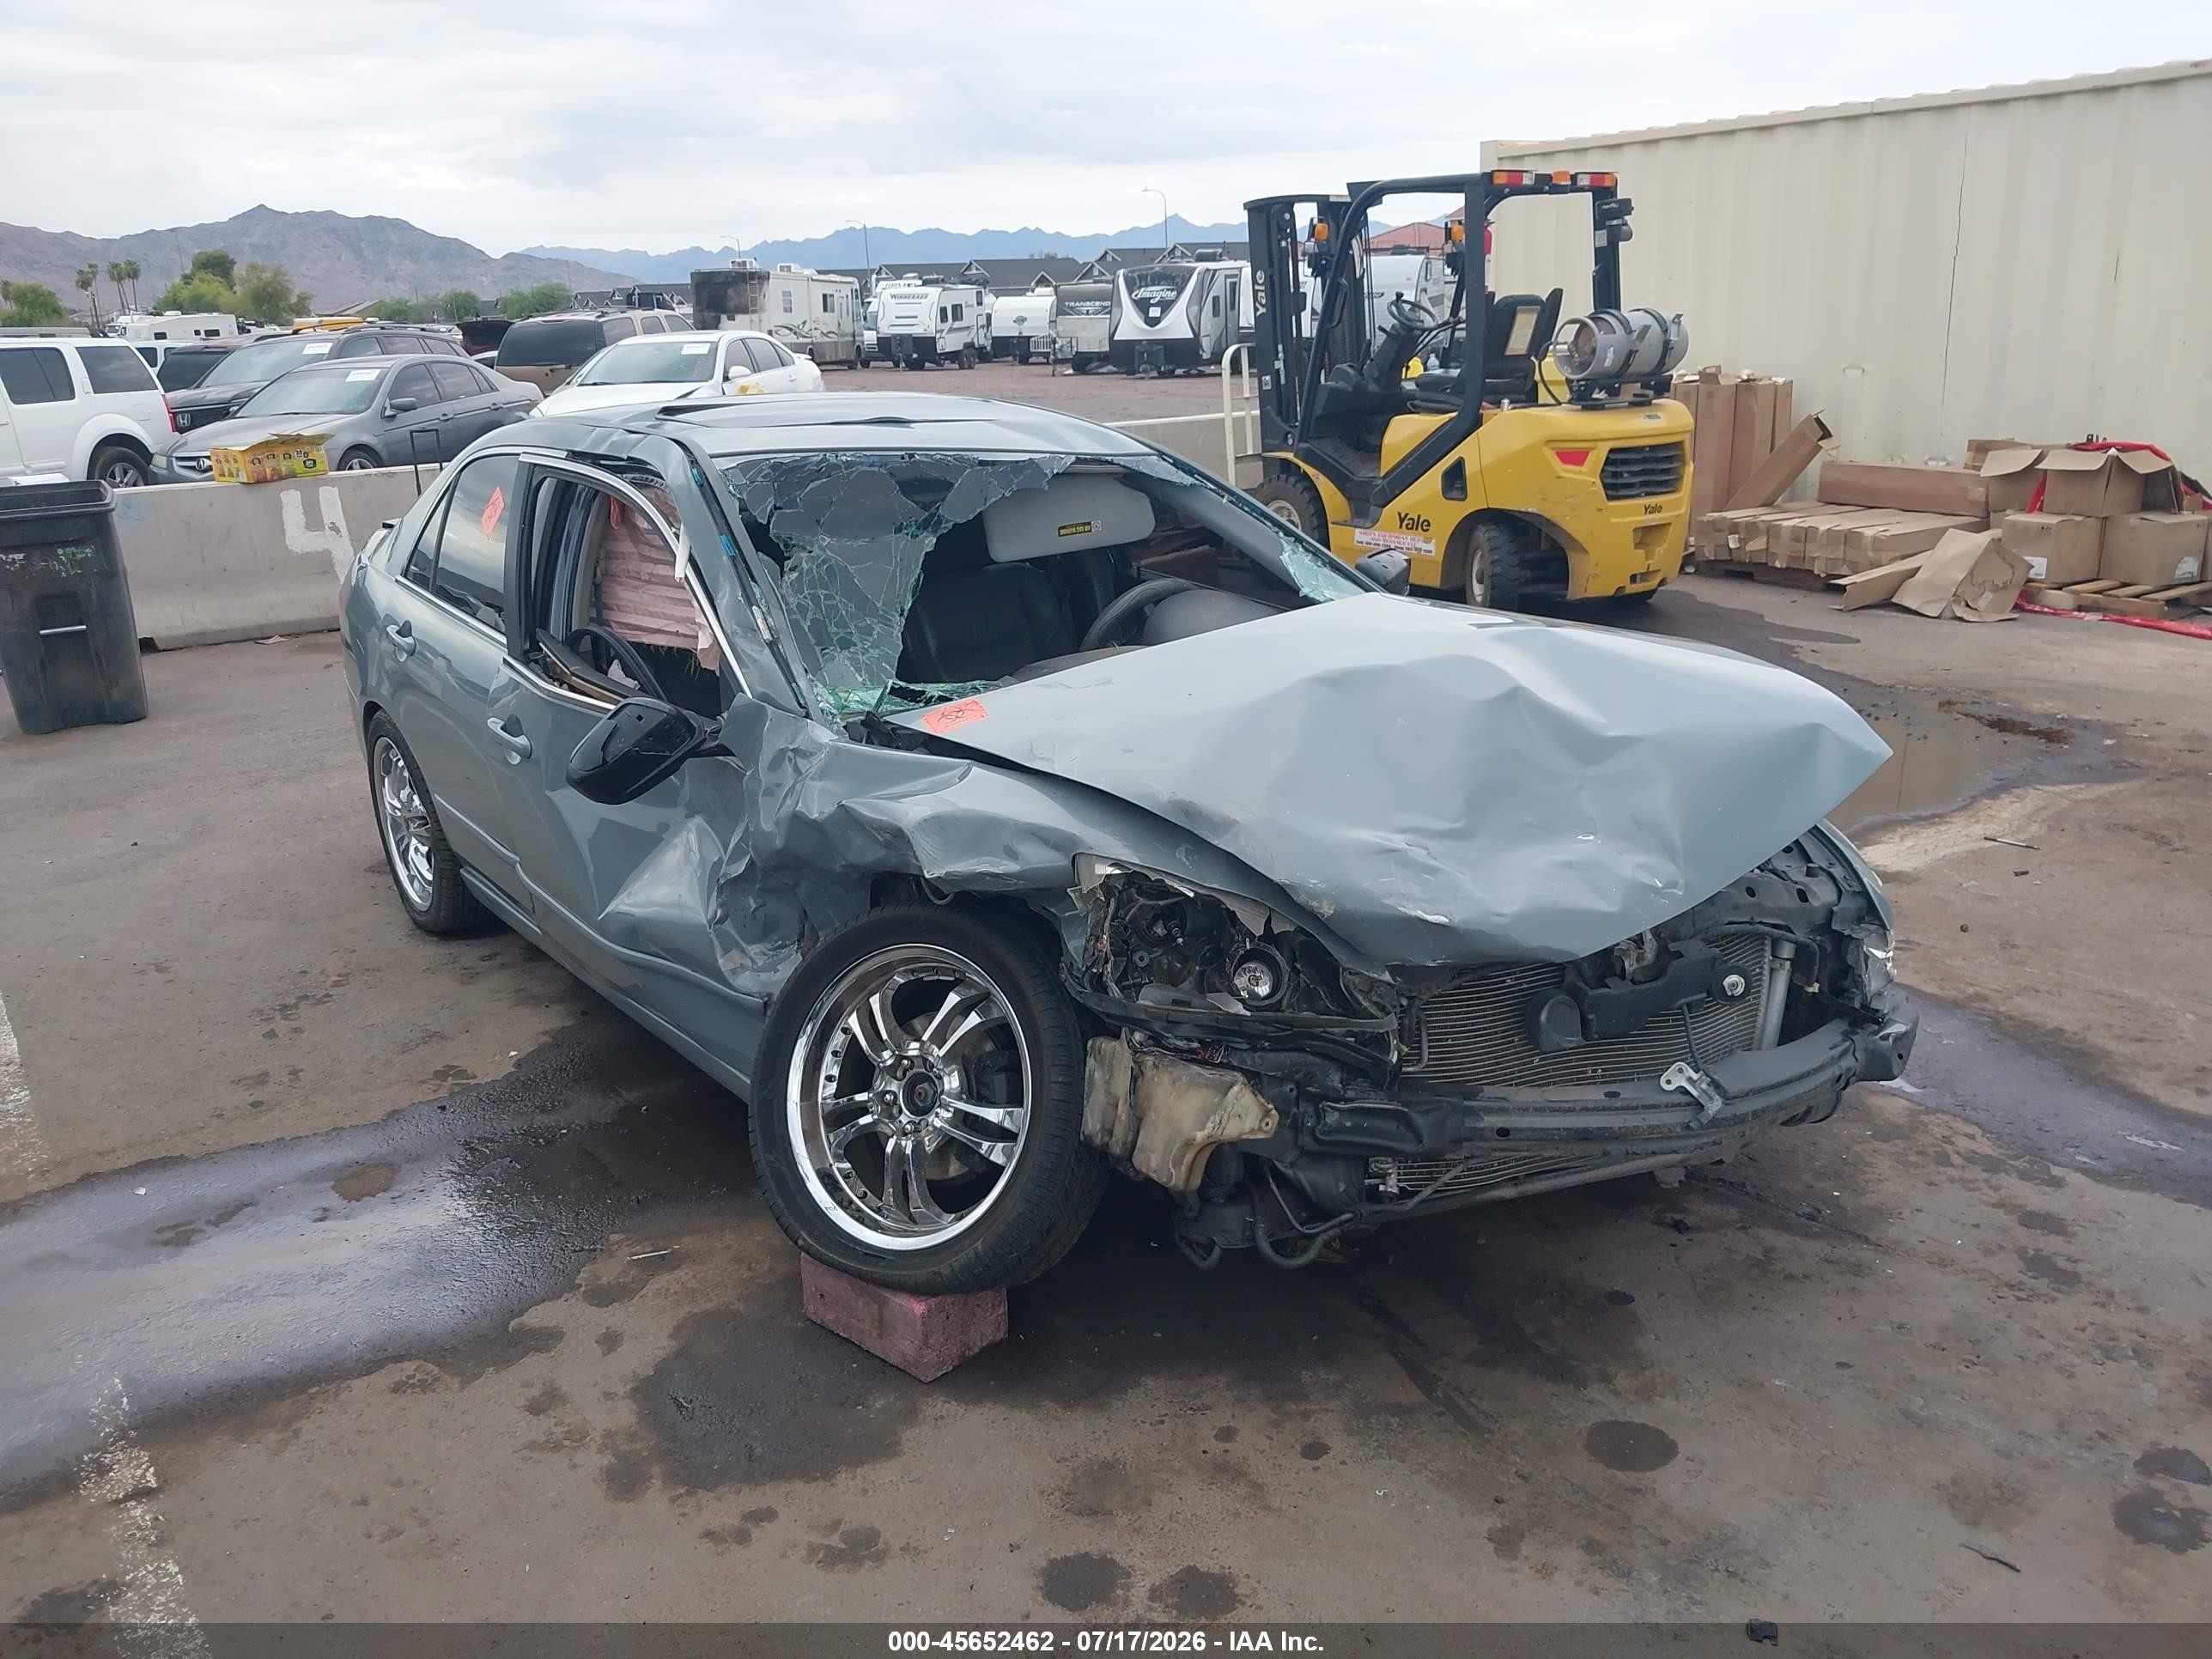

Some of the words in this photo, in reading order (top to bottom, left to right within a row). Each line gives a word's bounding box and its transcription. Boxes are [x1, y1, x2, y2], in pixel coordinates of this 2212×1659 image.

[1132, 286, 1177, 303] Imagine
[1255, 269, 1267, 317] Yale
[1644, 503, 1662, 515] Yale
[1397, 512, 1431, 532] Yale
[280, 486, 355, 586] 4
